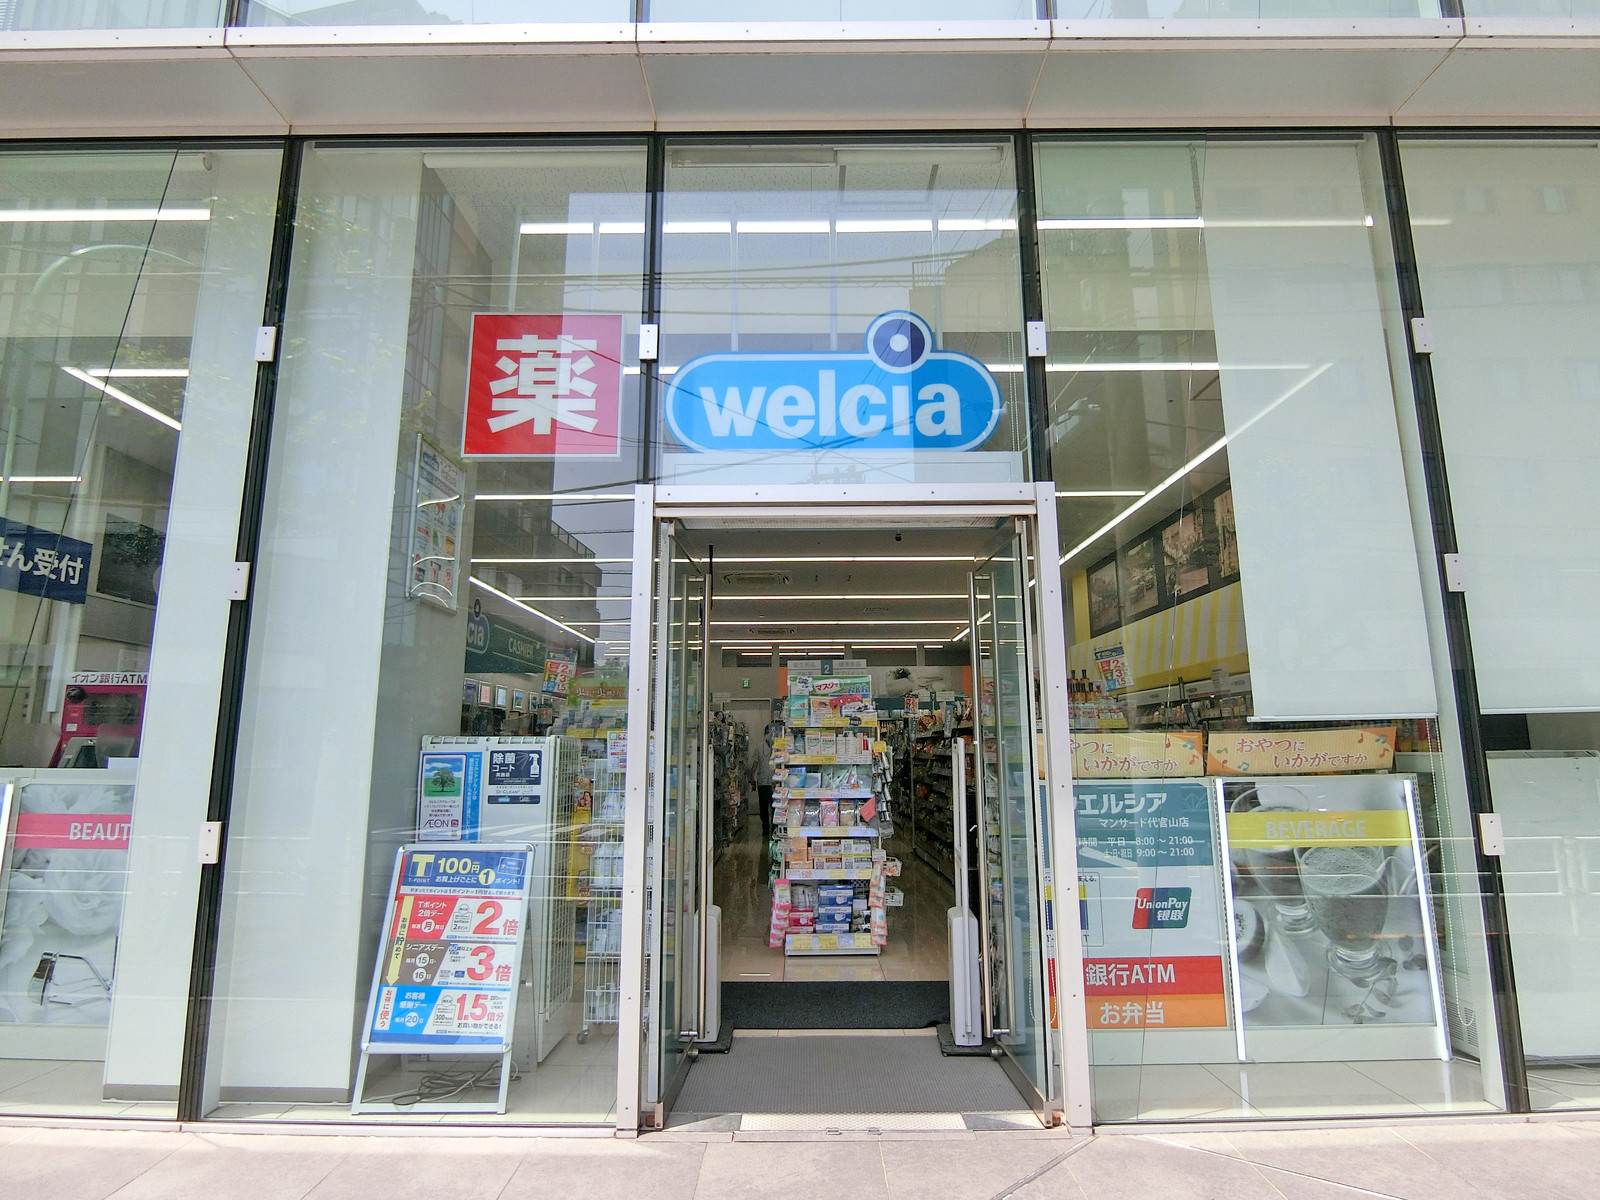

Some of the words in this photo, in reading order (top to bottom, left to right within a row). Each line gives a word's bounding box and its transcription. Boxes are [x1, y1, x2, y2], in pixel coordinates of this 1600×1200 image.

[487, 335, 598, 435] 薬
[699, 368, 962, 439] welcia
[508, 637, 535, 659] CASHIER
[824, 664, 830, 674] 2
[71, 672, 147, 684] イオン銀行ATM
[1235, 737, 1306, 754] おやつに
[492, 752, 516, 764] 除菌
[1083, 756, 1178, 772] いかがですか
[1274, 751, 1368, 769] いかがですか
[1074, 793, 1167, 815] エルシア
[1098, 816, 1190, 828] マンサード代官山店
[1265, 819, 1368, 839] BEVERAGE
[1107, 836, 1126, 847] 平日
[1135, 836, 1155, 846] 8:00
[1168, 836, 1194, 845] 21:00
[1136, 848, 1156, 857] 9:00
[1170, 847, 1195, 857] 21:00
[437, 858, 480, 874] 100円
[417, 901, 447, 909] Tポイント
[1137, 897, 1188, 911] UnionPay
[1156, 907, 1184, 921] 银联
[405, 992, 426, 1000] お客様
[1099, 1001, 1165, 1024] お弁当
